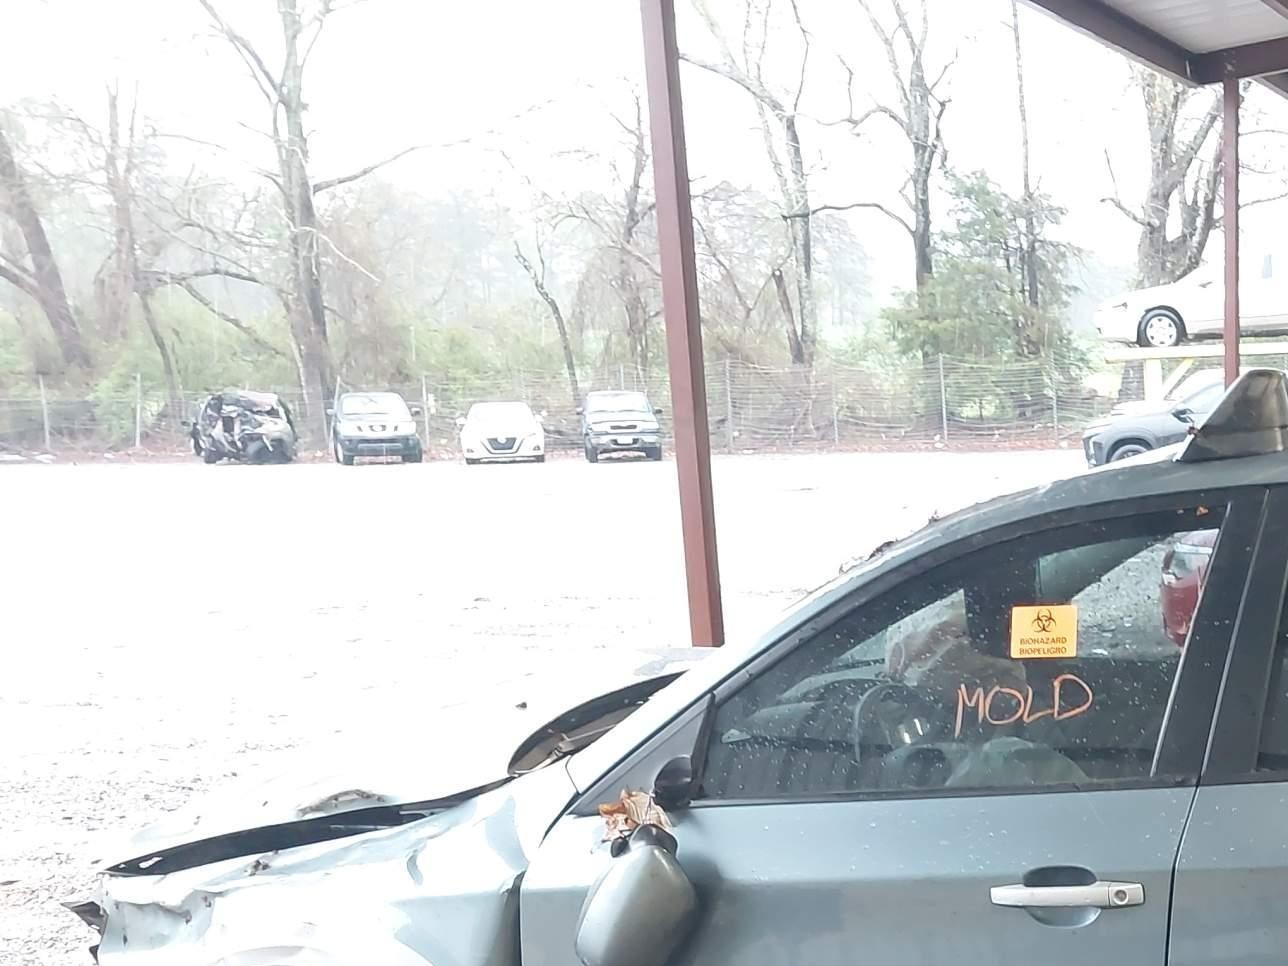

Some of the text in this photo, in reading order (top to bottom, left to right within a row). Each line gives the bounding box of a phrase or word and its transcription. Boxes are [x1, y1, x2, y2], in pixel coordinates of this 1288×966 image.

[1019, 637, 1067, 645] BIOHAZARD
[1019, 647, 1067, 655] BIOPELIGRO
[954, 673, 1093, 738] MOLD
